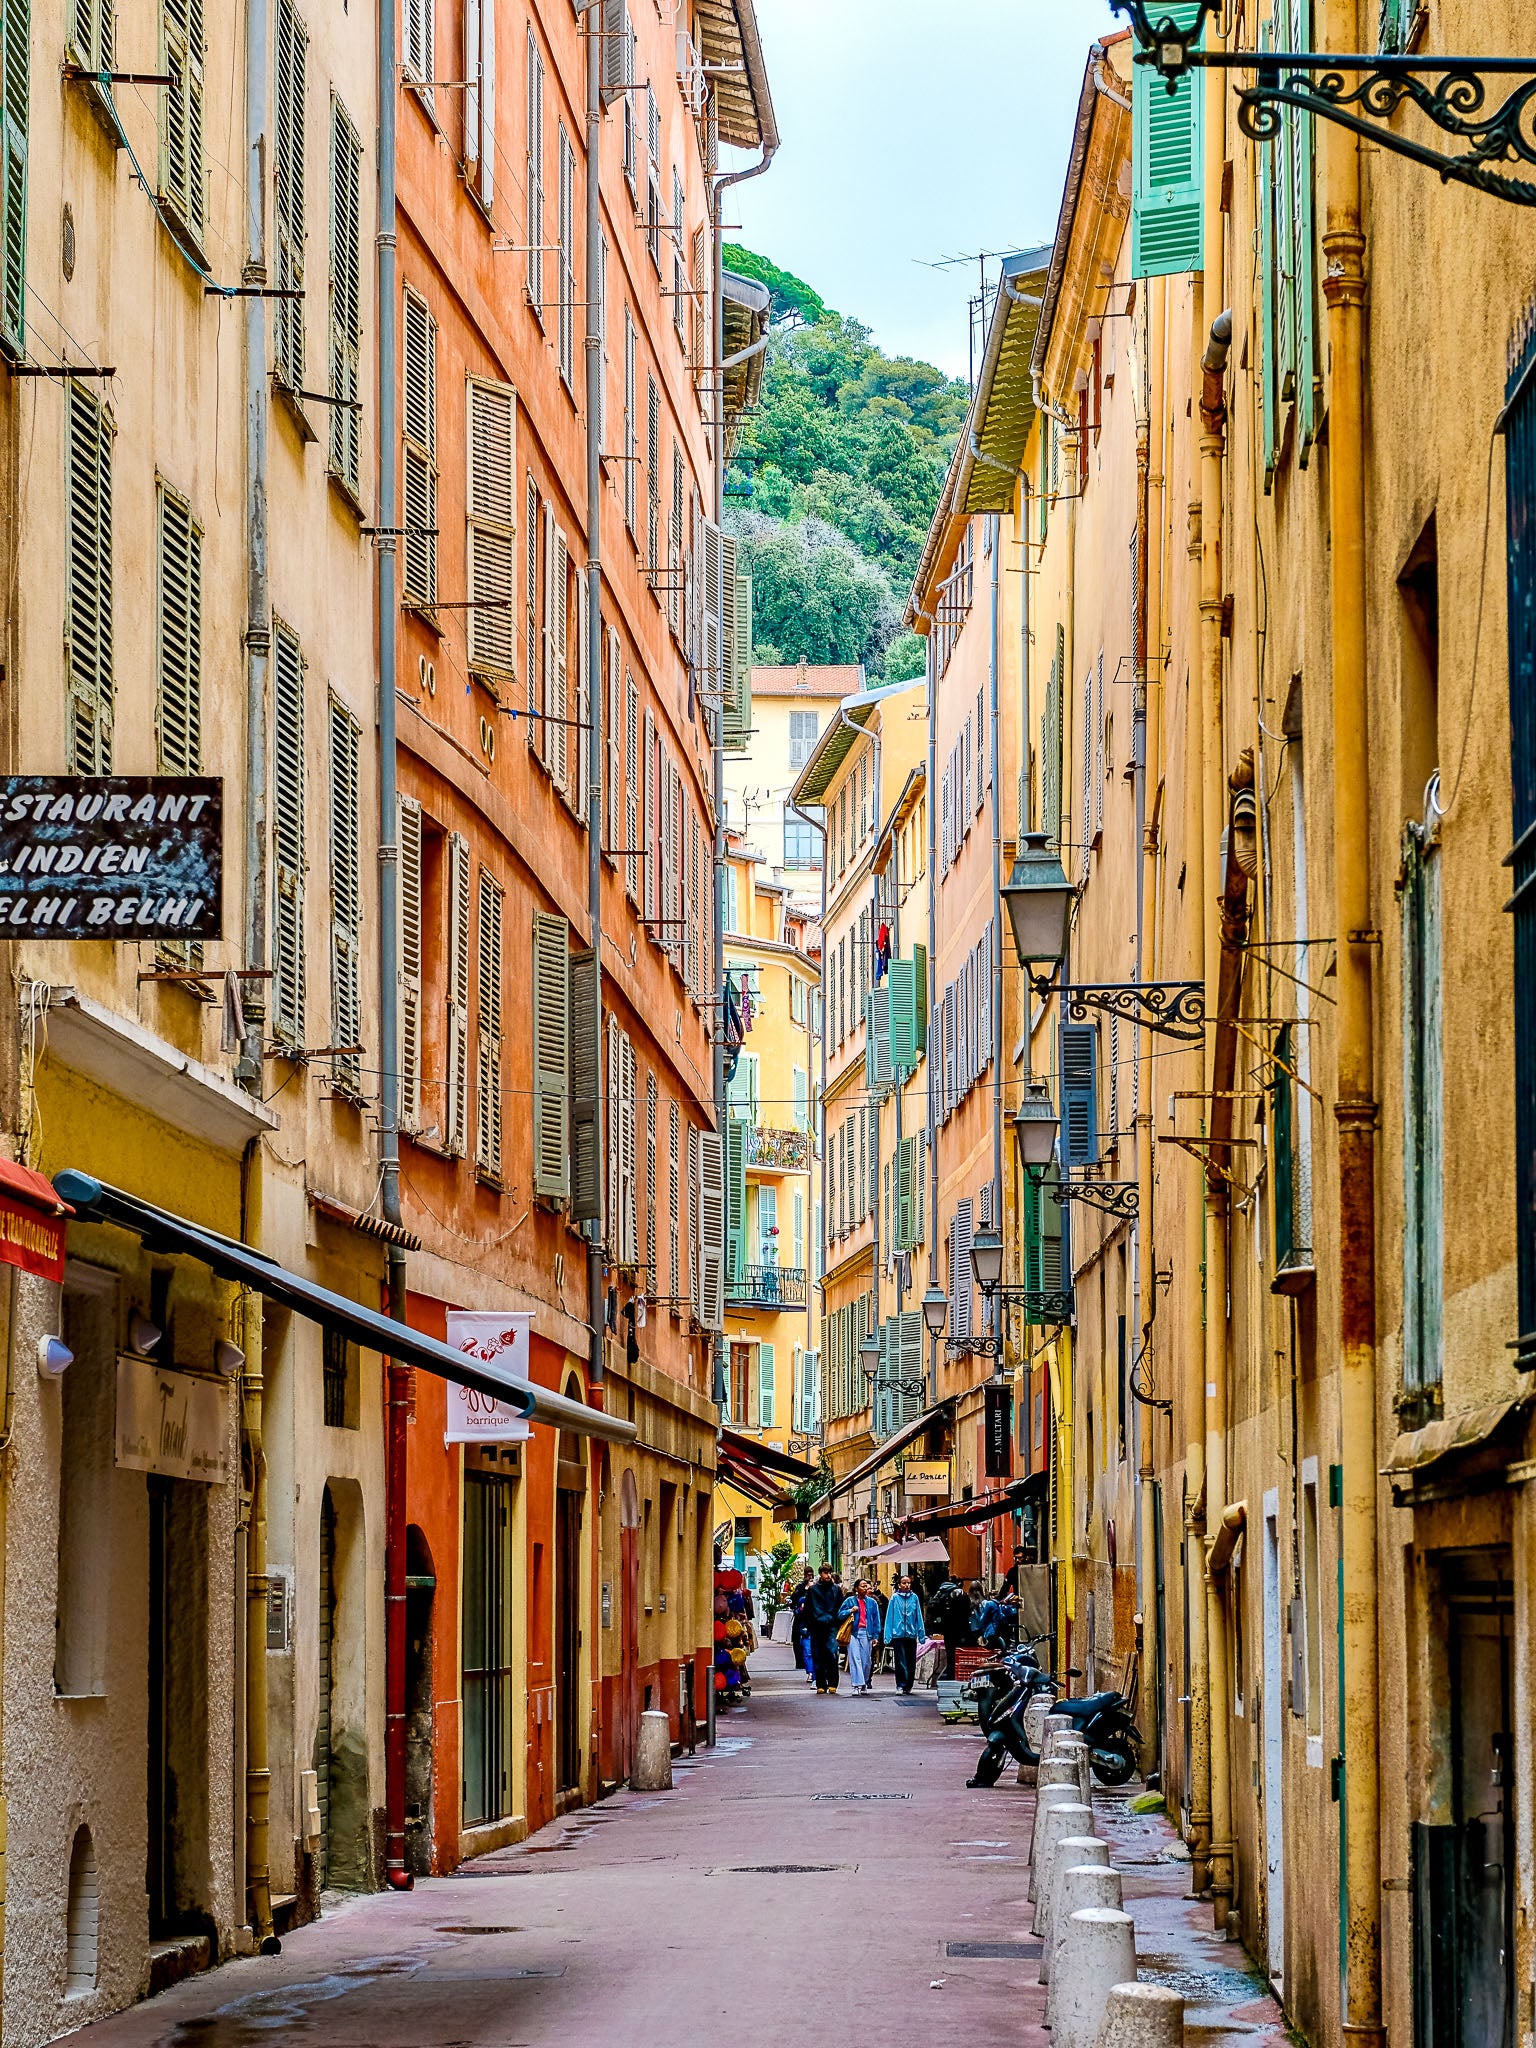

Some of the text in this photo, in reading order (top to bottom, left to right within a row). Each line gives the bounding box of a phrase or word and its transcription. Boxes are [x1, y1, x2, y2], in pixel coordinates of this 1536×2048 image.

[12, 845, 151, 873] INDIEN
[86, 897, 204, 926] BELHI
[466, 1415, 510, 1427] barrique
[906, 1472, 947, 1481] Le Panier
